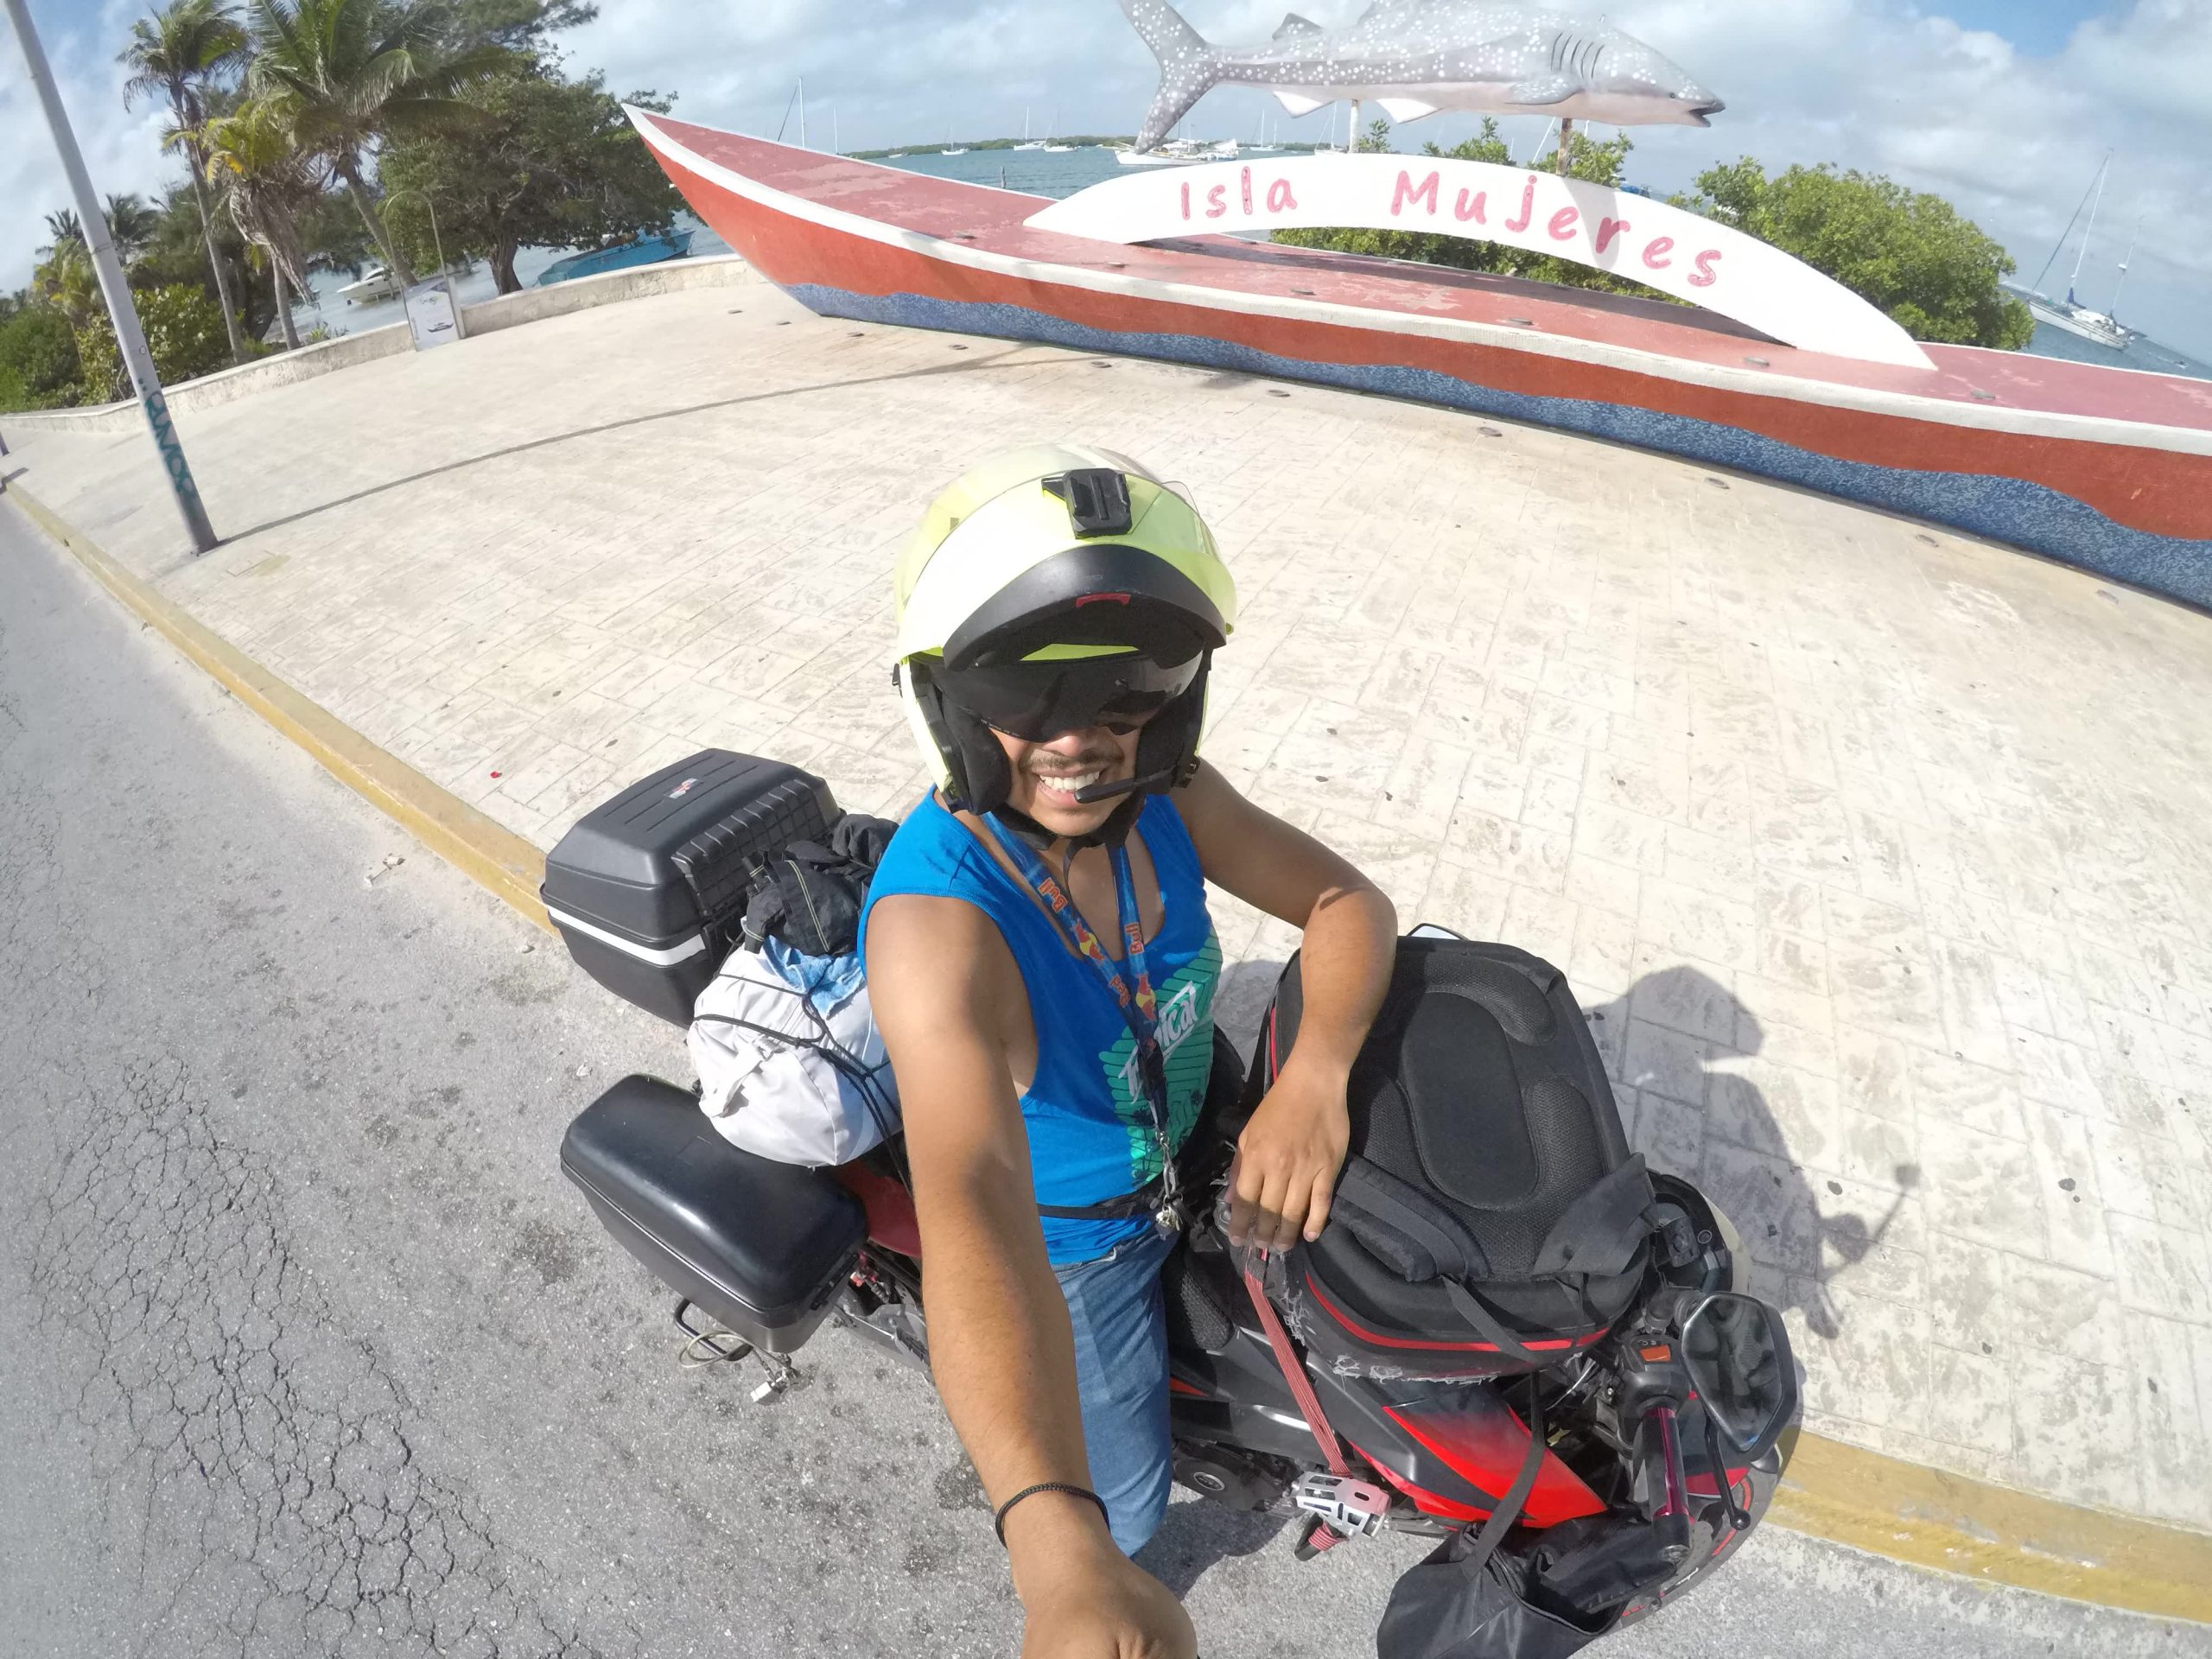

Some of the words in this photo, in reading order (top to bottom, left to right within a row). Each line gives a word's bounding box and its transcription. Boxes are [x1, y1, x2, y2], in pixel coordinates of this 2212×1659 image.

[1180, 166, 1298, 220] Isla
[1390, 170, 1722, 287] Mujeres
[1037, 877, 1068, 913] Bull
[1124, 922, 1144, 955] Bull
